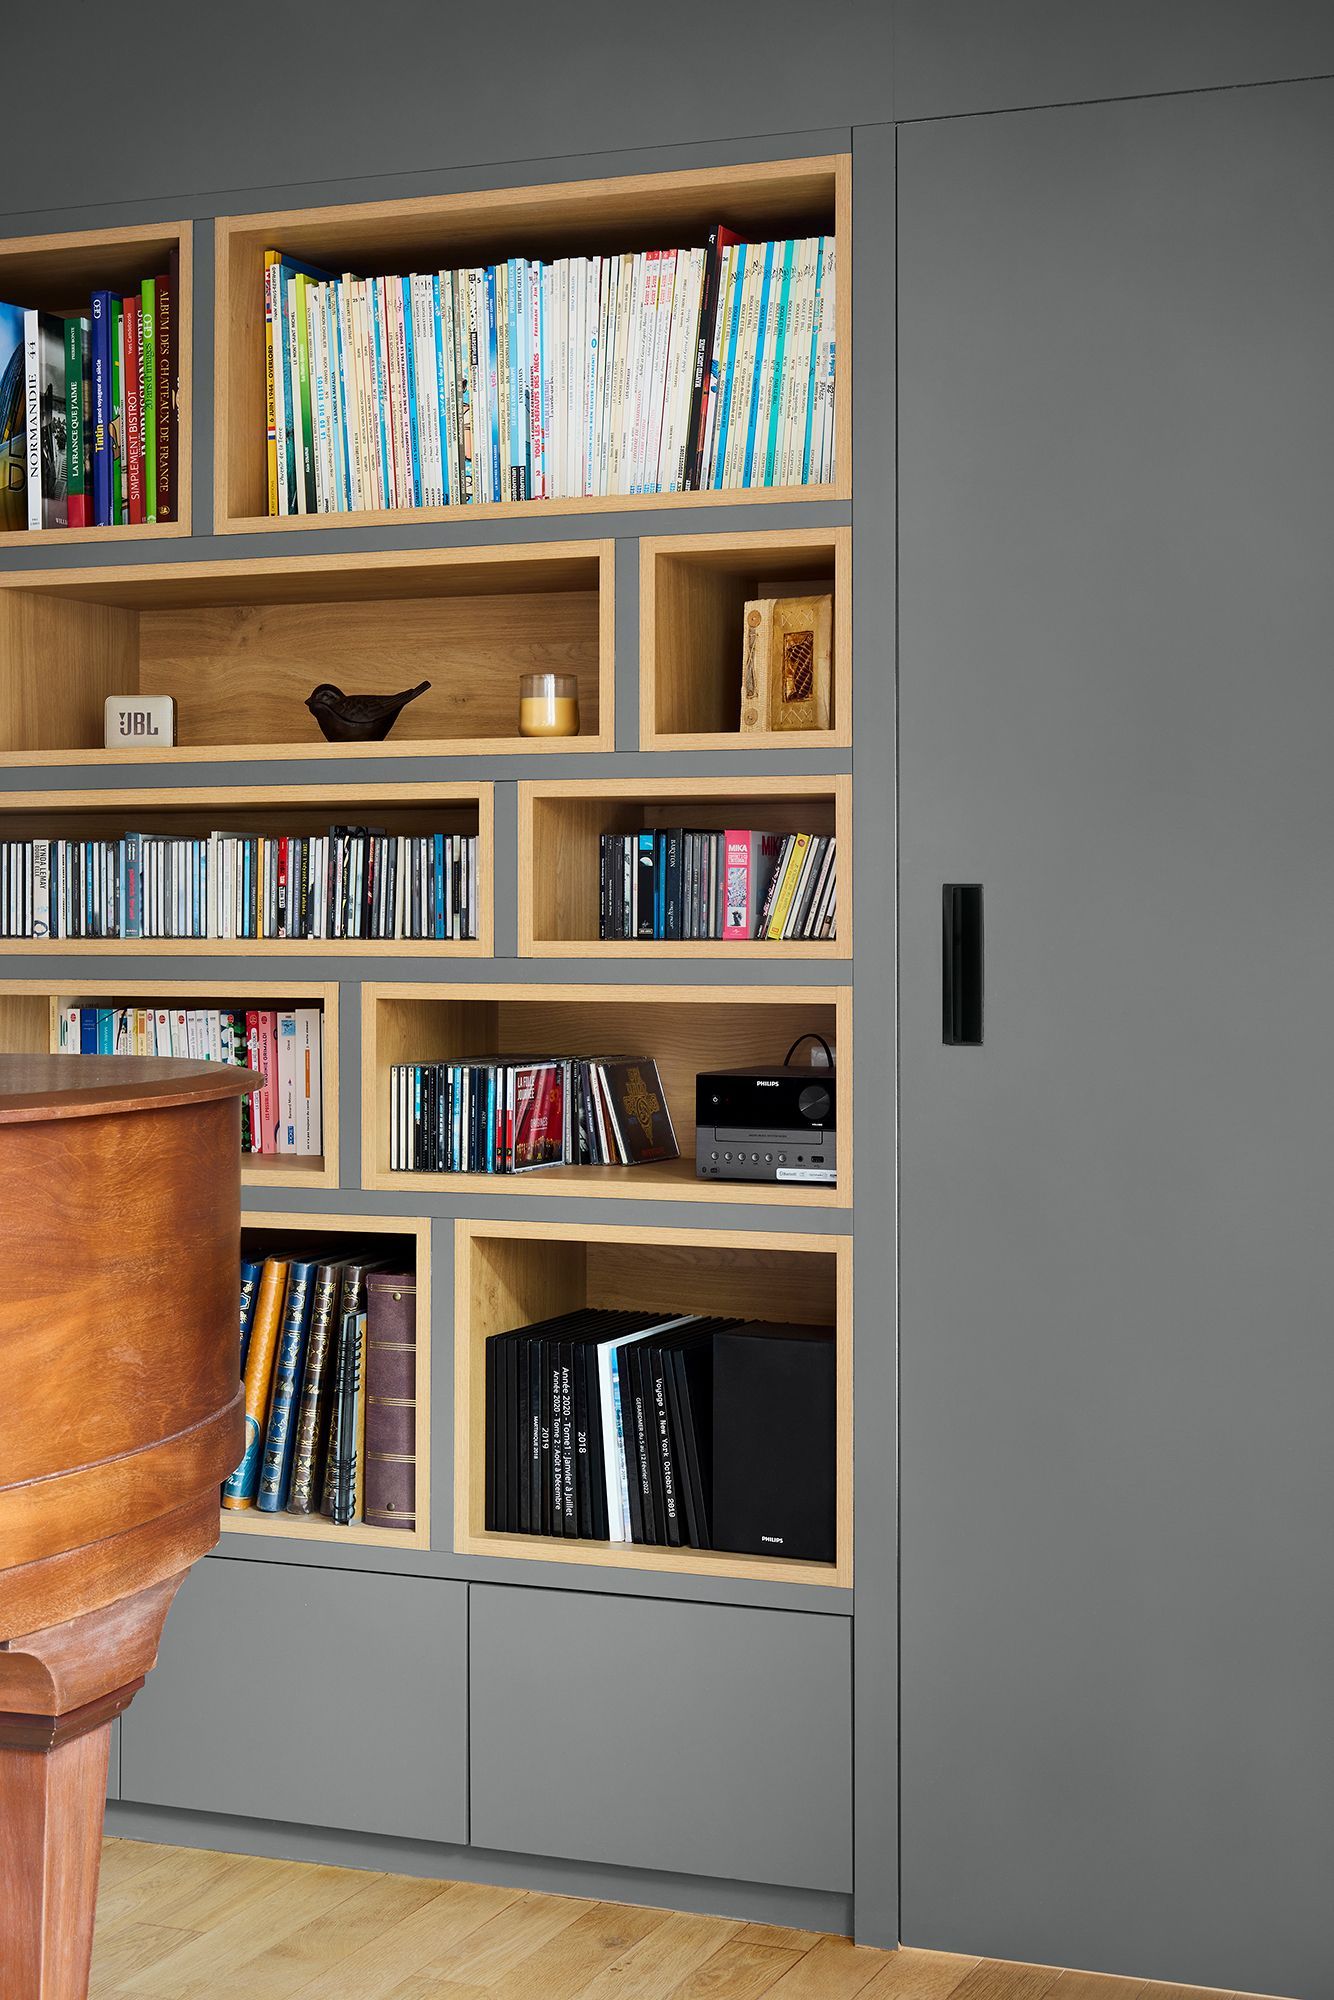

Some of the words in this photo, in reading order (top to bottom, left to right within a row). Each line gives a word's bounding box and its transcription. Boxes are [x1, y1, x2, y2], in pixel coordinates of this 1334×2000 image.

[160, 288, 169, 329] ALBUM
[143, 313, 152, 339] GEO
[27, 341, 36, 359] 44
[160, 335, 169, 354] DES
[698, 338, 706, 352] LUKE
[144, 343, 153, 383] d'images
[697, 352, 705, 367] LUCKY
[71, 381, 79, 410] J'AIME
[160, 358, 169, 423] CHATEAUX
[128, 391, 138, 432] BISTROT
[145, 399, 153, 410] 20
[28, 373, 38, 478] NORMANDIE
[71, 411, 79, 429] QUE
[95, 425, 104, 453] Tintin
[160, 427, 169, 441] DE
[72, 465, 79, 477] LA
[129, 435, 140, 500] SIMPLEMENT
[160, 446, 169, 492] FRANCE
[119, 712, 159, 736] JBL
[728, 844, 748, 852] MIKA
[761, 835, 780, 857] MIK
[39, 867, 47, 890] LEMAY
[517, 1077, 524, 1089] LA
[552, 1370, 560, 1393] Année
[561, 1366, 570, 1394] Année
[655, 1378, 663, 1407] Voyage
[562, 1395, 570, 1416] 2020
[635, 1397, 645, 1432] GERARDMER
[541, 1427, 549, 1449] 2019
[563, 1422, 571, 1450] Tome1
[577, 1431, 586, 1454] 2018
[639, 1432, 645, 1440] du
[661, 1438, 669, 1457] York
[554, 1449, 562, 1466] Août
[640, 1445, 645, 1453] au
[562, 1455, 572, 1485] Janvier
[663, 1461, 673, 1495] Octobre
[554, 1473, 562, 1510] Décembre
[642, 1480, 650, 1495] 2022
[564, 1492, 573, 1516] Juillet
[668, 1498, 676, 1518] 2019
[761, 1535, 784, 1544] PHILIPS
